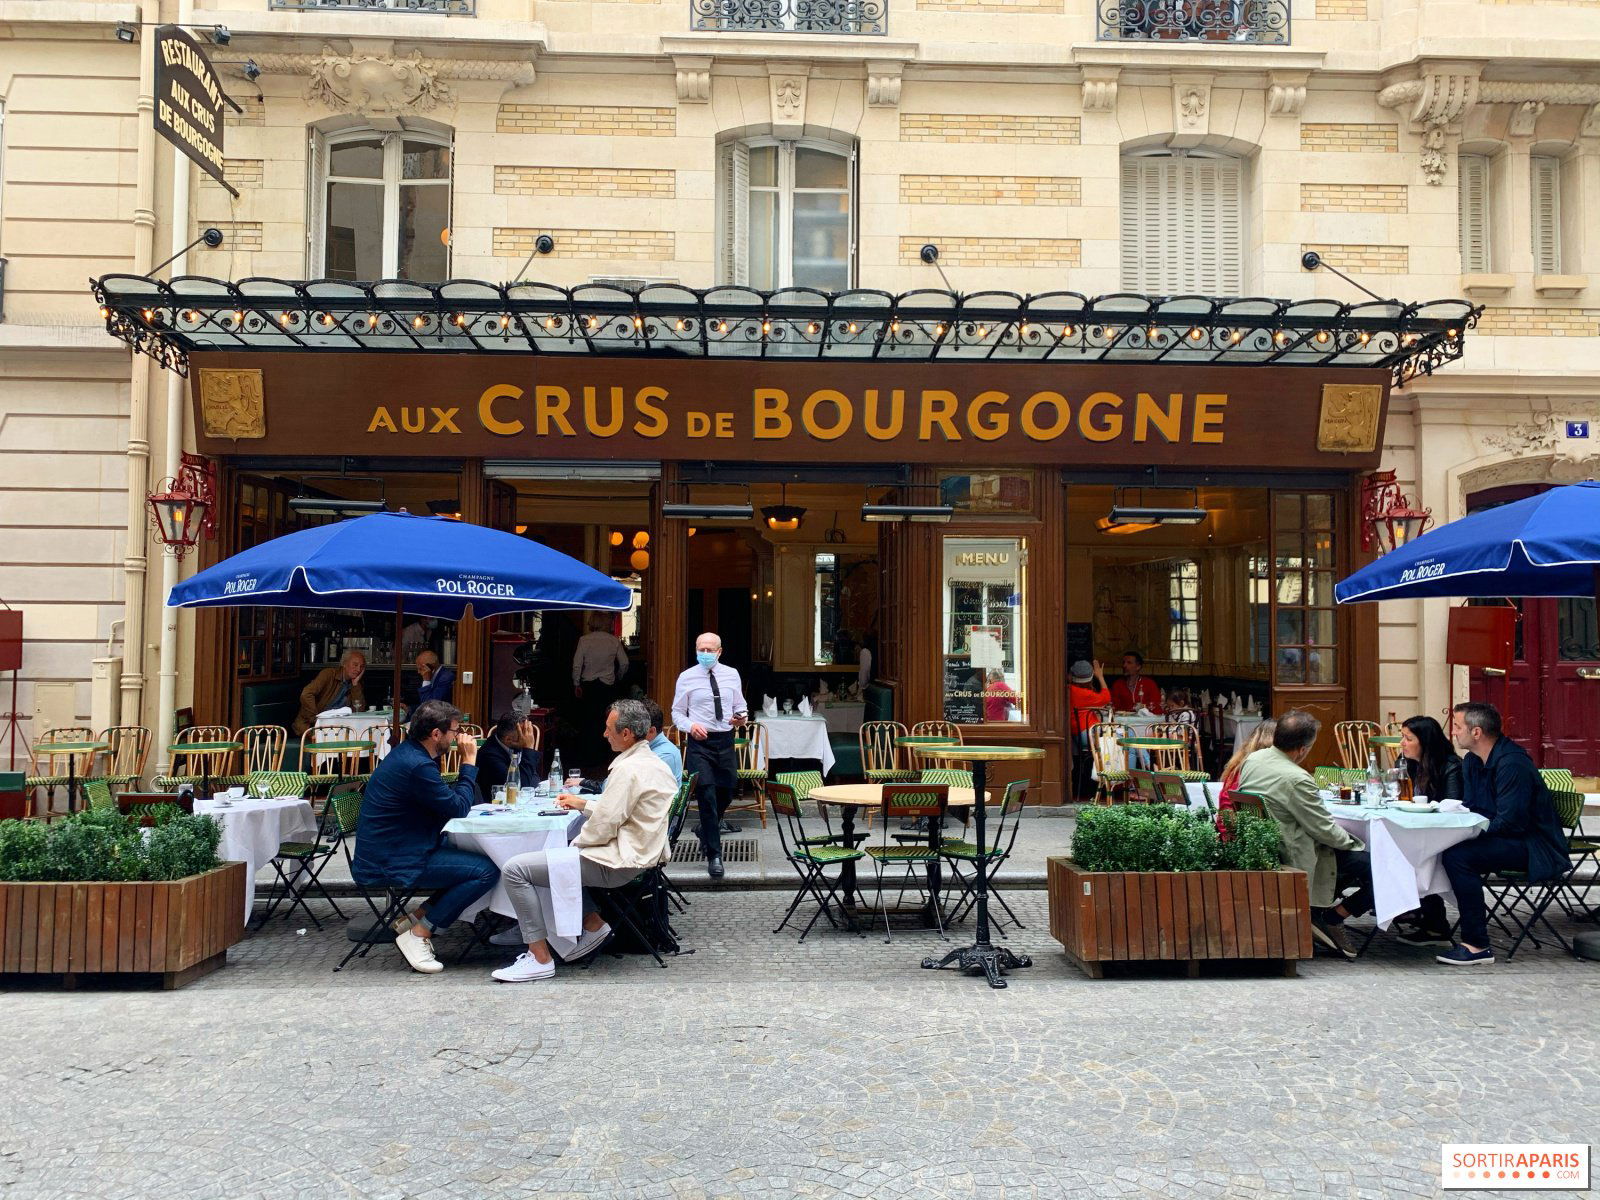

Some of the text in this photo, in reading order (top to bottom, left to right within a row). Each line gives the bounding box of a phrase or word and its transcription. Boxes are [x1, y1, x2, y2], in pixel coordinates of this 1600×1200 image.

[160, 38, 225, 112] RESTAURANT
[171, 79, 215, 133] AUX CRUS
[159, 98, 224, 171] DE BOURGOGNE
[367, 383, 1228, 444] AUX CRUS DE BOURGOGNE
[1574, 423, 1583, 436] 3
[961, 552, 1010, 564] MENU
[458, 573, 495, 581] CHAMPAGNE
[1400, 562, 1446, 583] POL ROGER
[223, 578, 257, 594] POL ROGER
[436, 578, 515, 596] POL ROGER
[980, 690, 1025, 698] BOURGOGNE
